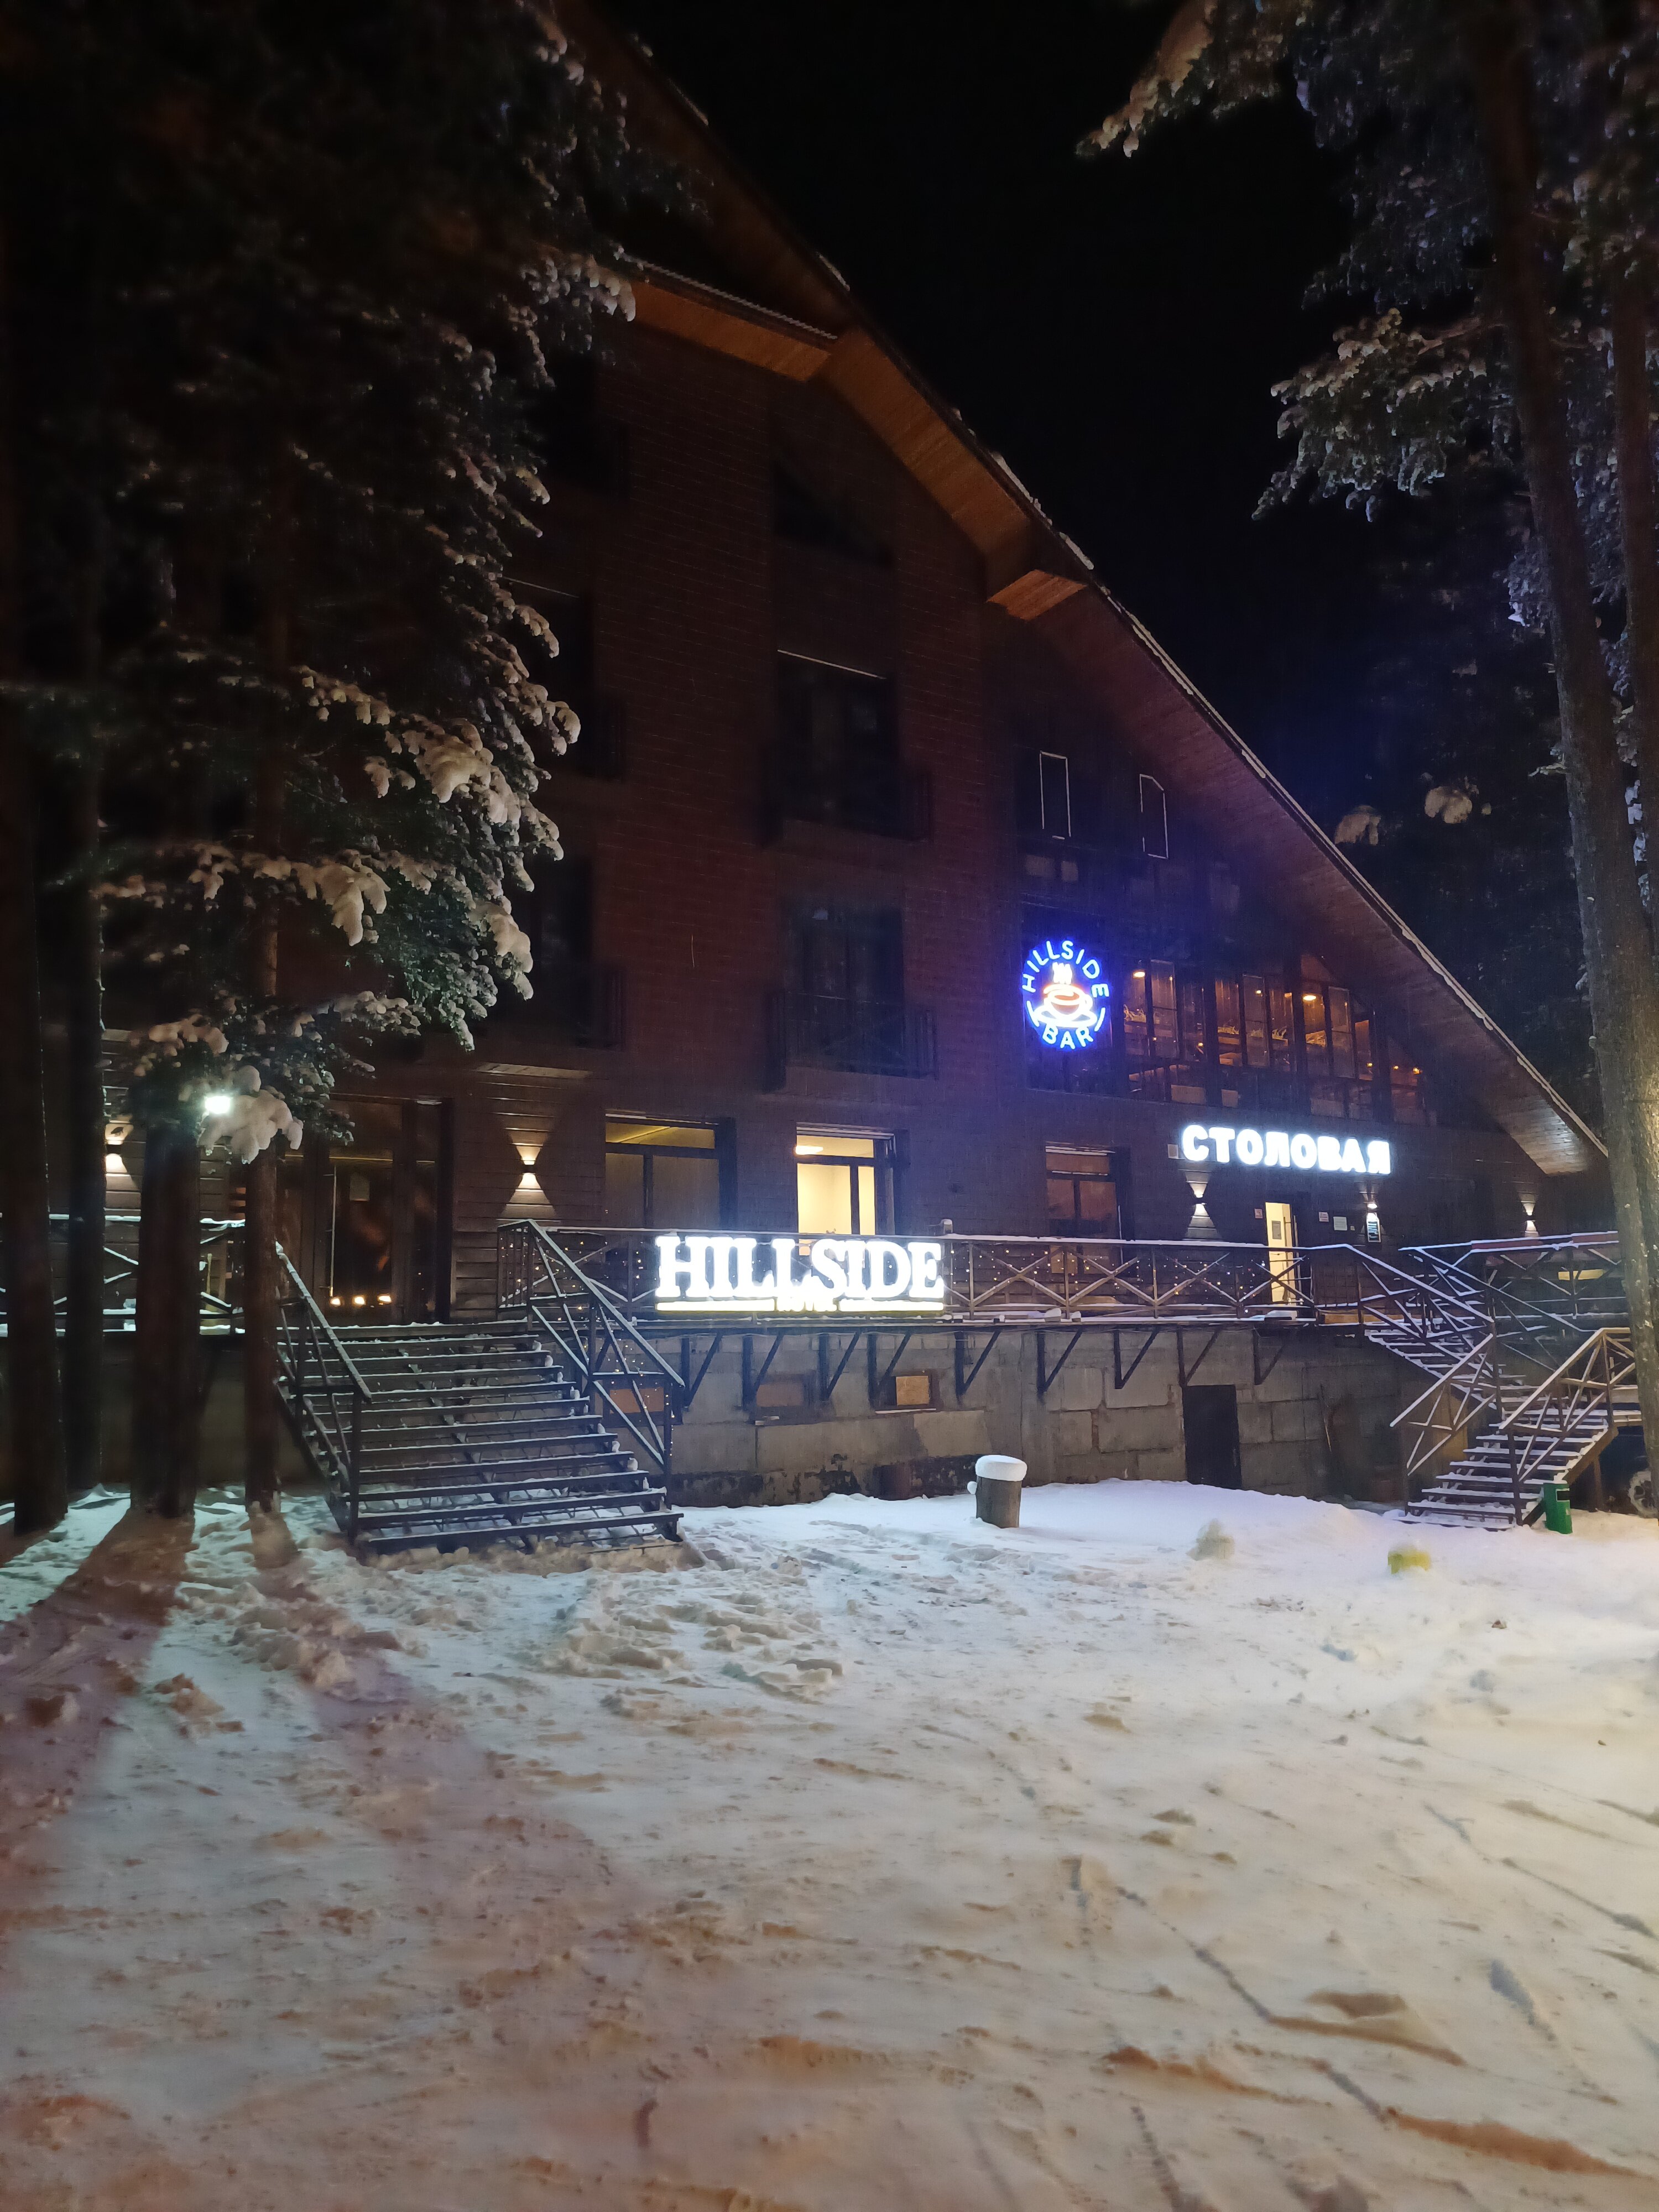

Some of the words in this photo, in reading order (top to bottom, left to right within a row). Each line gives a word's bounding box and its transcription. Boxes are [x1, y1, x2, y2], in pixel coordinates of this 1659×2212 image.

[1022, 940, 1110, 998] HILLSIDE
[1042, 1025, 1094, 1050] BAR
[1182, 1124, 1391, 1175] СТОЛОВАЯ
[656, 1235, 945, 1298] HILLSIDE
